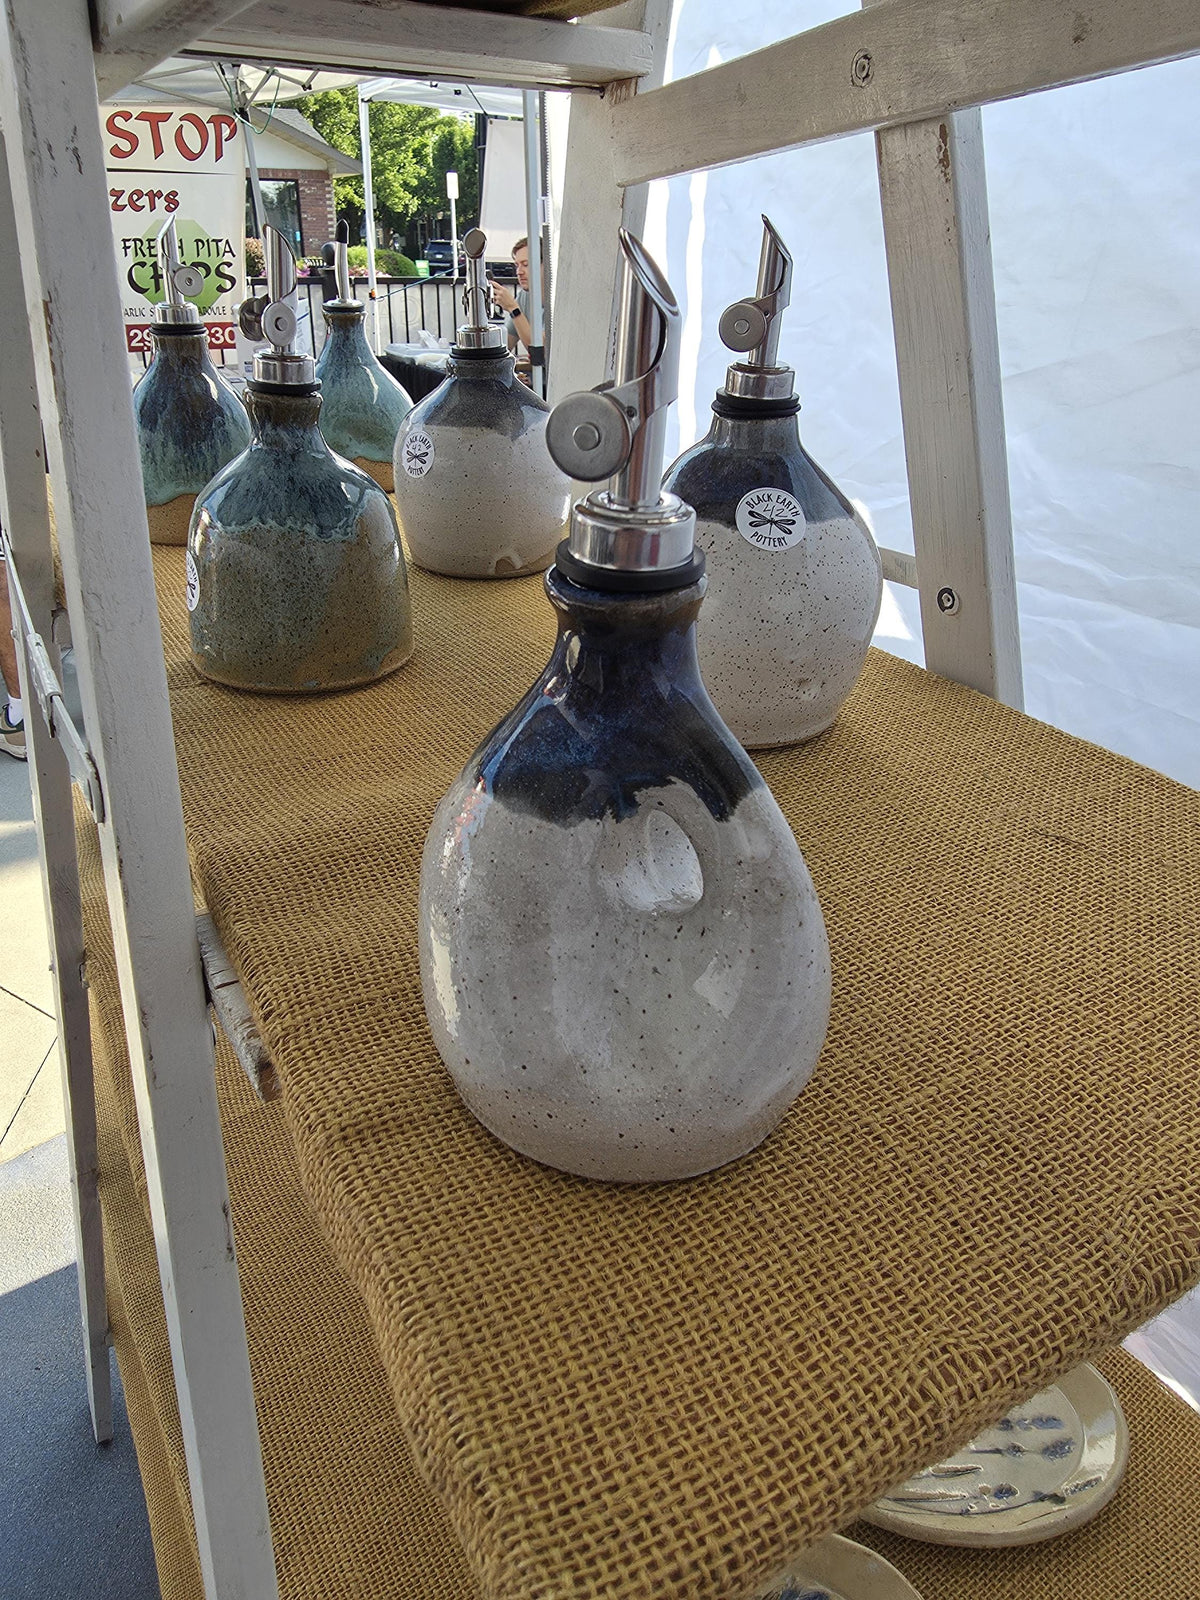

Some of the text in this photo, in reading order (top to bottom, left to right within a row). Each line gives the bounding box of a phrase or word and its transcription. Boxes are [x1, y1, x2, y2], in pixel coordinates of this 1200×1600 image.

[106, 110, 237, 162] STOP
[121, 238, 236, 258] FREH PITA
[127, 261, 237, 294] CHPS
[745, 493, 801, 517] BLACK EARTH
[750, 532, 787, 547] POTTERY
